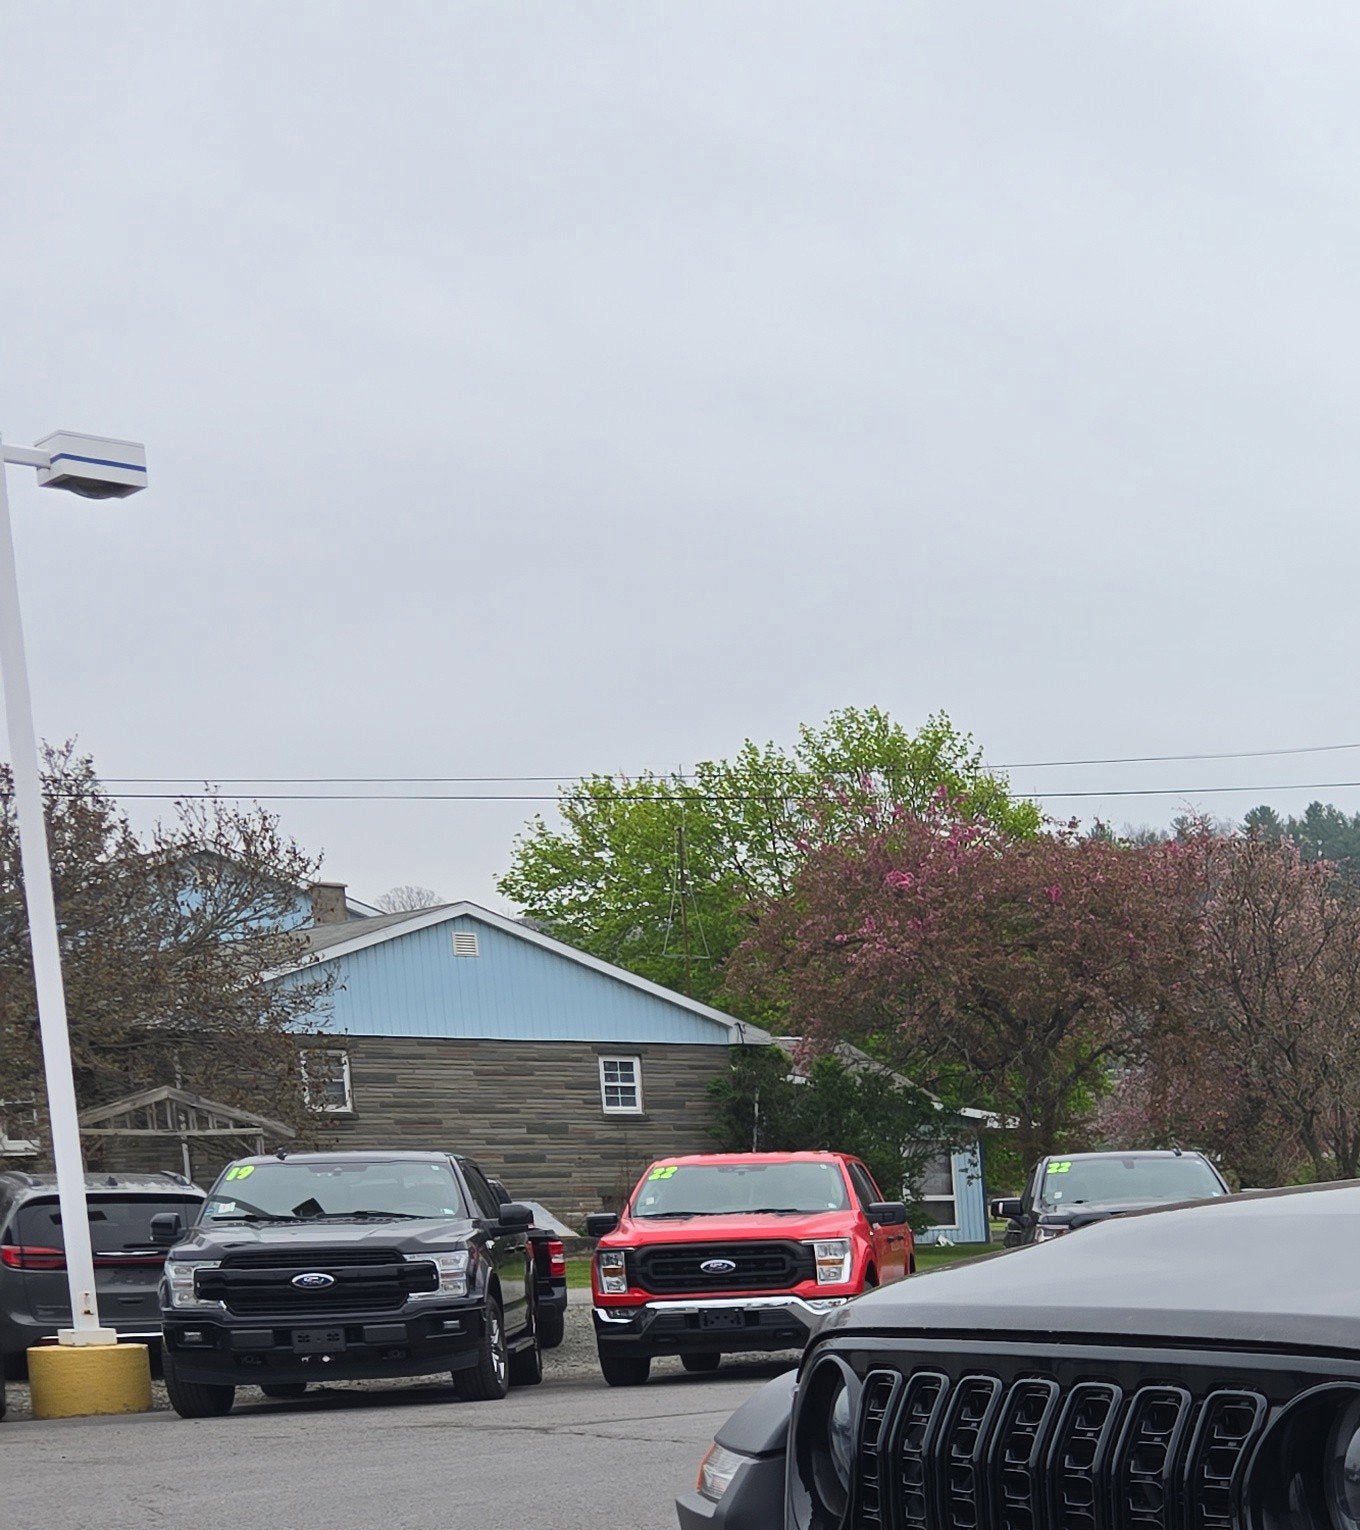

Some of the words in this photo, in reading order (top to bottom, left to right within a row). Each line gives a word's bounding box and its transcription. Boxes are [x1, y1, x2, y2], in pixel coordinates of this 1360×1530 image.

[226, 1166, 255, 1180] 19
[648, 1166, 678, 1180] 22
[1046, 1161, 1071, 1173] 22
